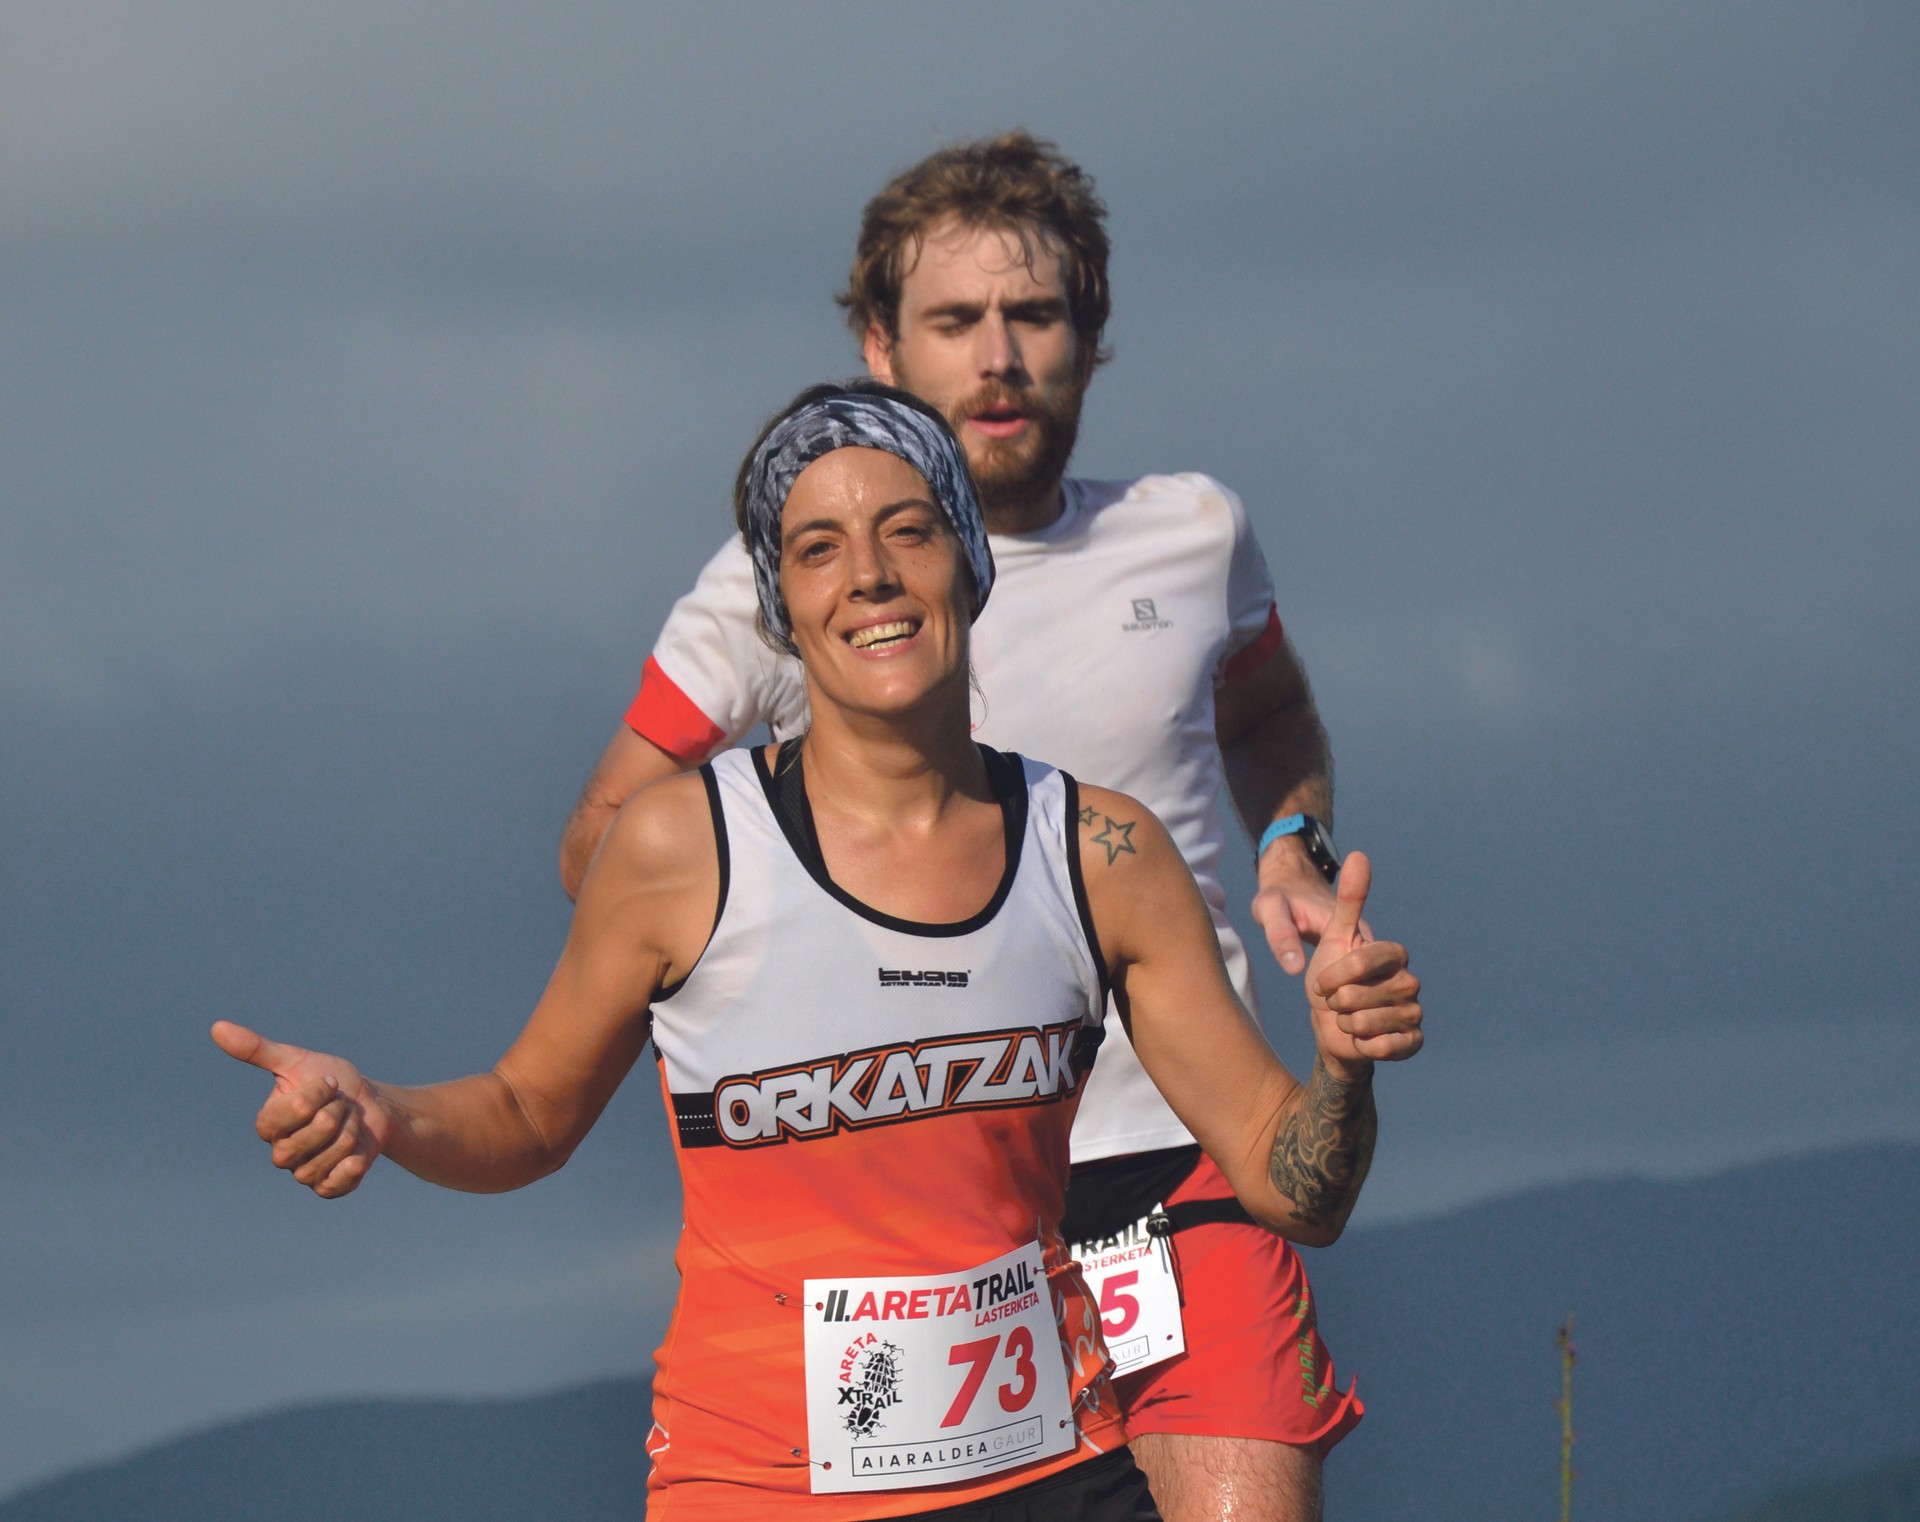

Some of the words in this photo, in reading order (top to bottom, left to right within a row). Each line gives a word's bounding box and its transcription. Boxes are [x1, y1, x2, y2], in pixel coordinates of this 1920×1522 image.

[716, 1027, 1078, 1142] ORKATZAK
[1082, 1246, 1153, 1273] STERKETA
[974, 1292, 1040, 1328] LASTERKETA
[839, 1332, 878, 1384] ARETA
[1111, 1344, 1142, 1361] AUR
[939, 1325, 1037, 1429] 73
